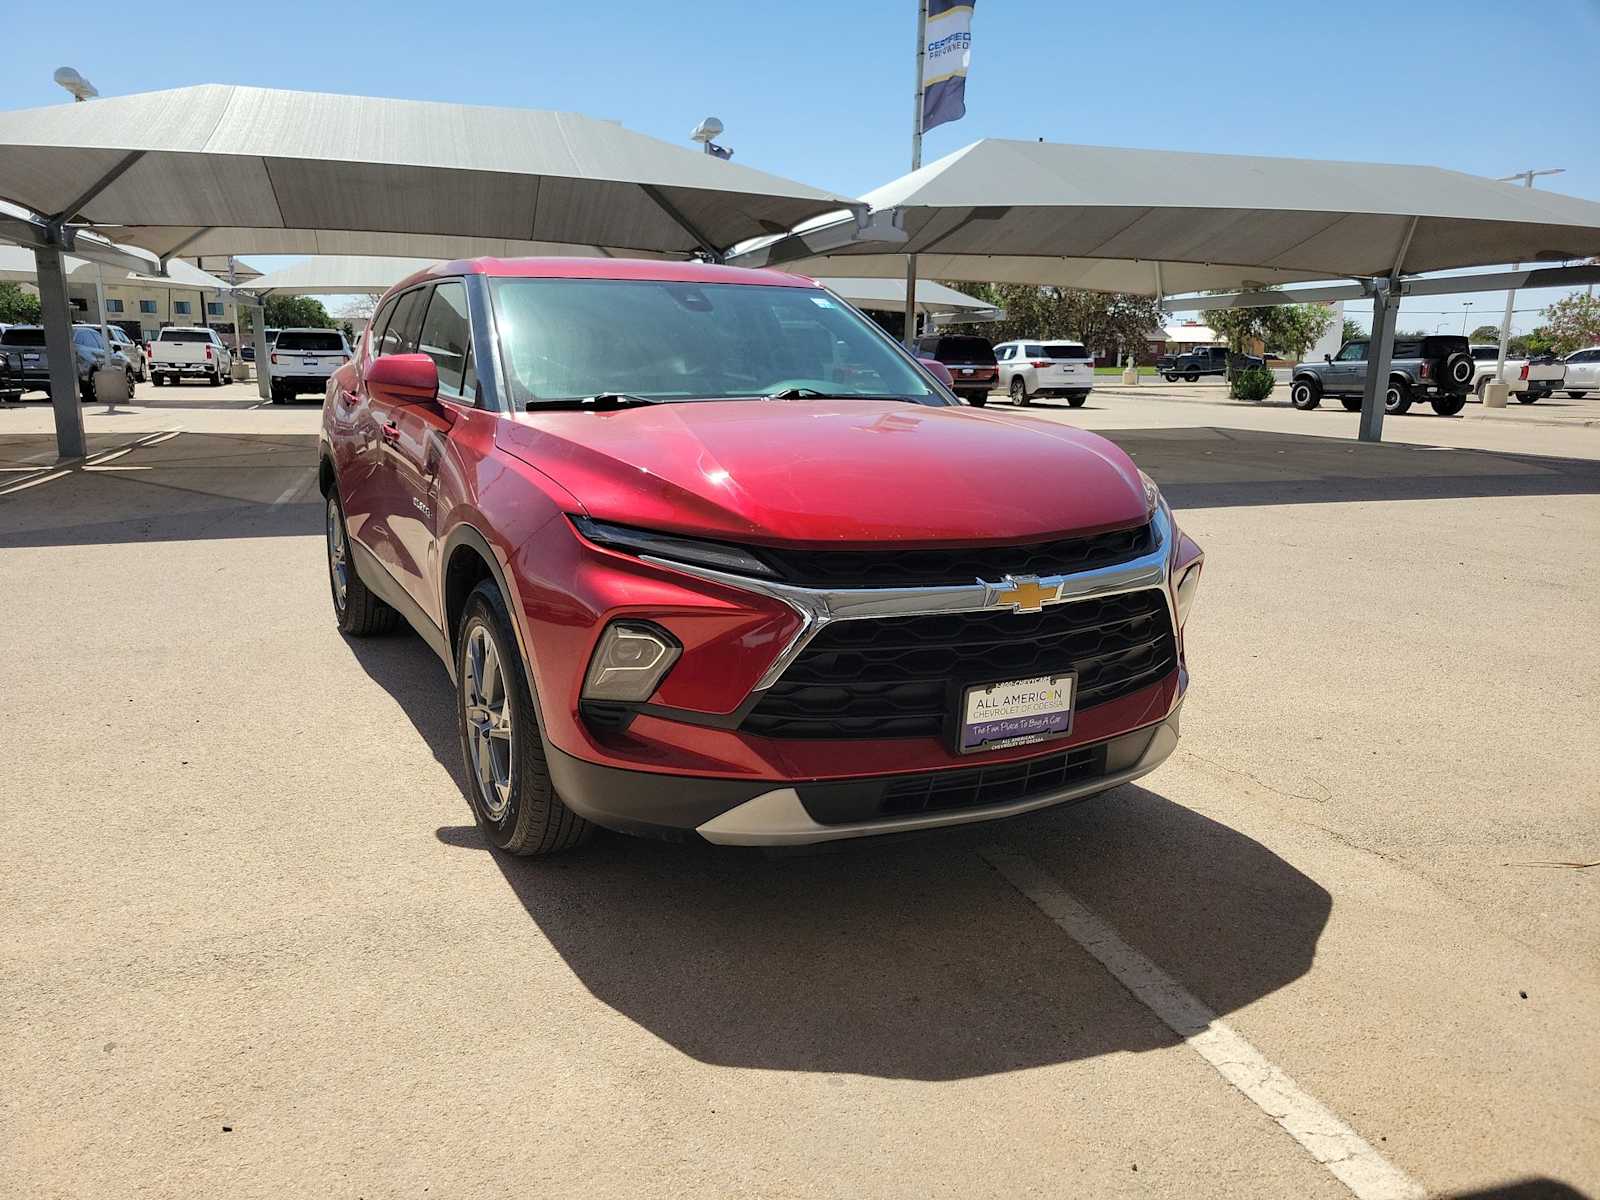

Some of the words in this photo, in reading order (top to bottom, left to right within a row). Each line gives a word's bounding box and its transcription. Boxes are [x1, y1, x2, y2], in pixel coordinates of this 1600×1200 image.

[976, 699, 999, 709] ALL
[973, 706, 1019, 719] CHEVROLET
[1021, 704, 1033, 712] OF
